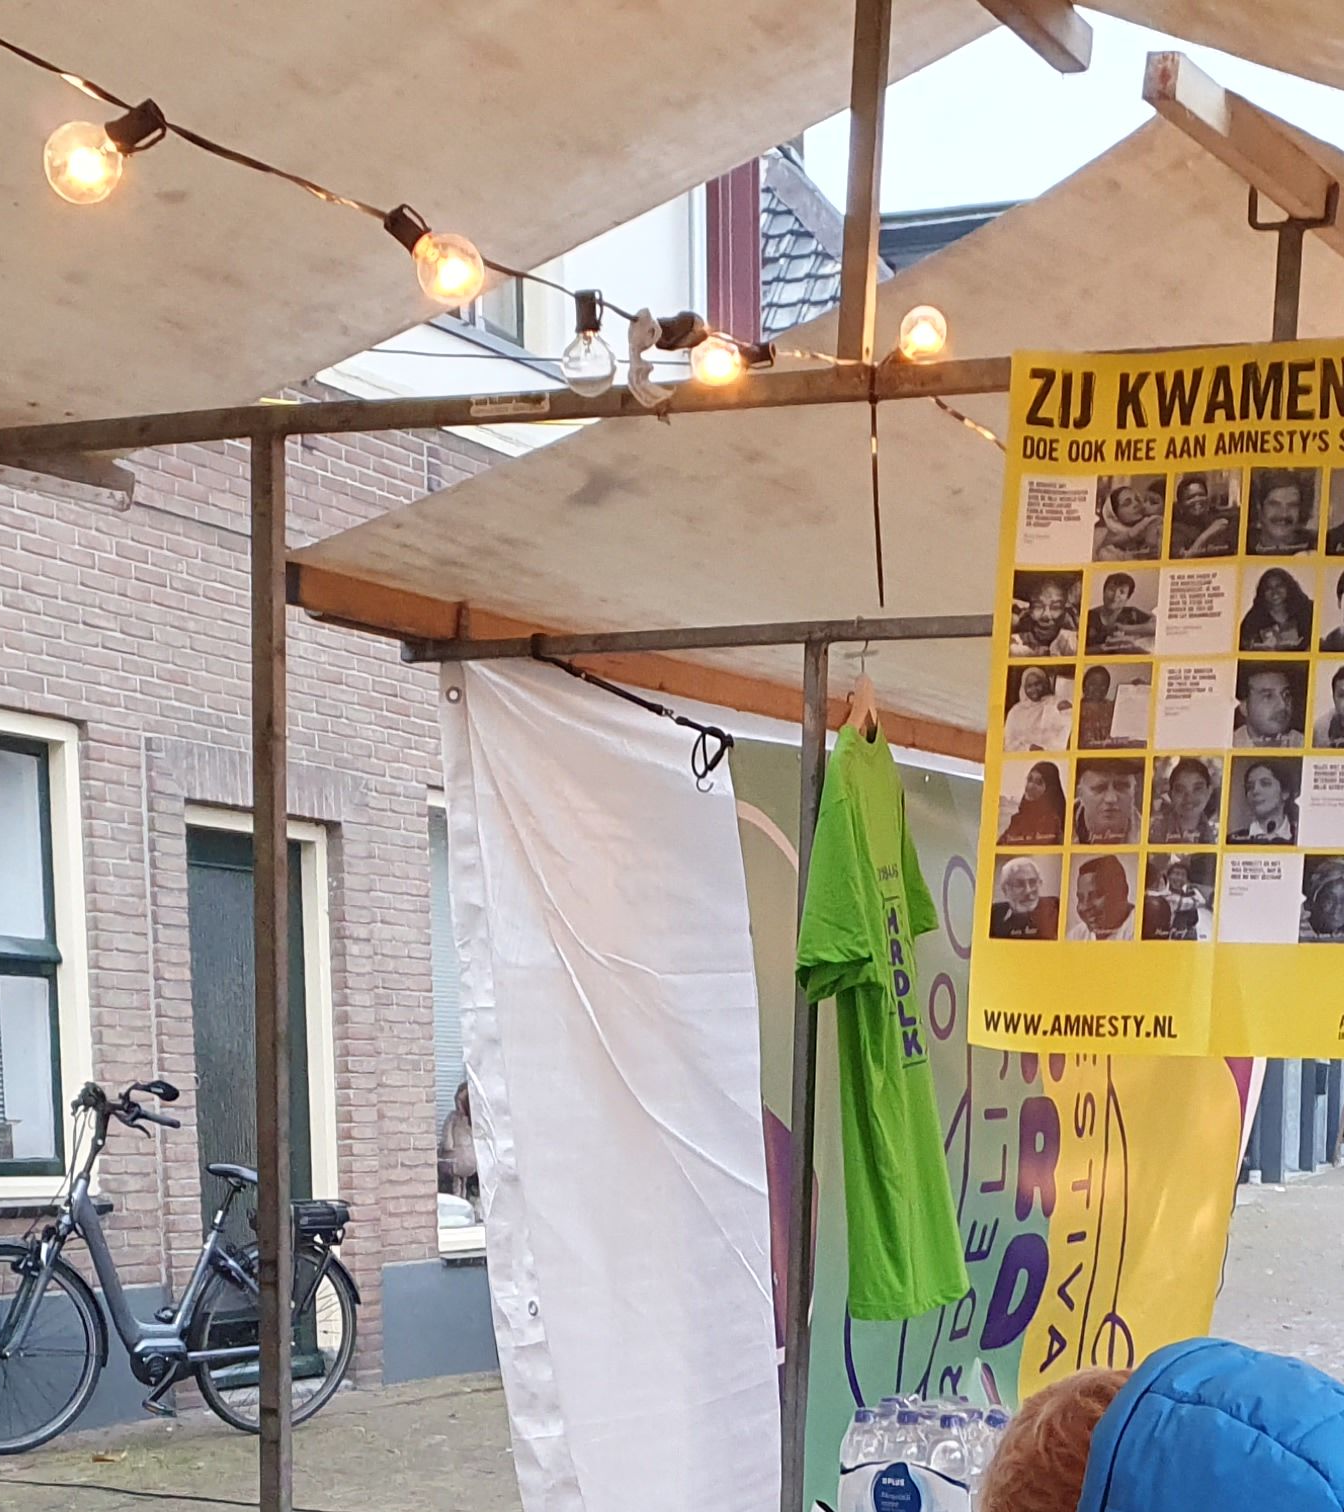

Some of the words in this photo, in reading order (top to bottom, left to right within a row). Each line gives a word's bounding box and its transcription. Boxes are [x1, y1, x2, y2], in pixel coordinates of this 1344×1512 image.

[1026, 367, 1095, 430] ZIJ
[1022, 436, 1059, 462] DOE
[1068, 435, 1106, 462] OOK
[1114, 436, 1156, 462] MEE
[1164, 430, 1207, 460] AAN
[983, 1009, 1177, 1039] WWW.AMNESTY.NL
